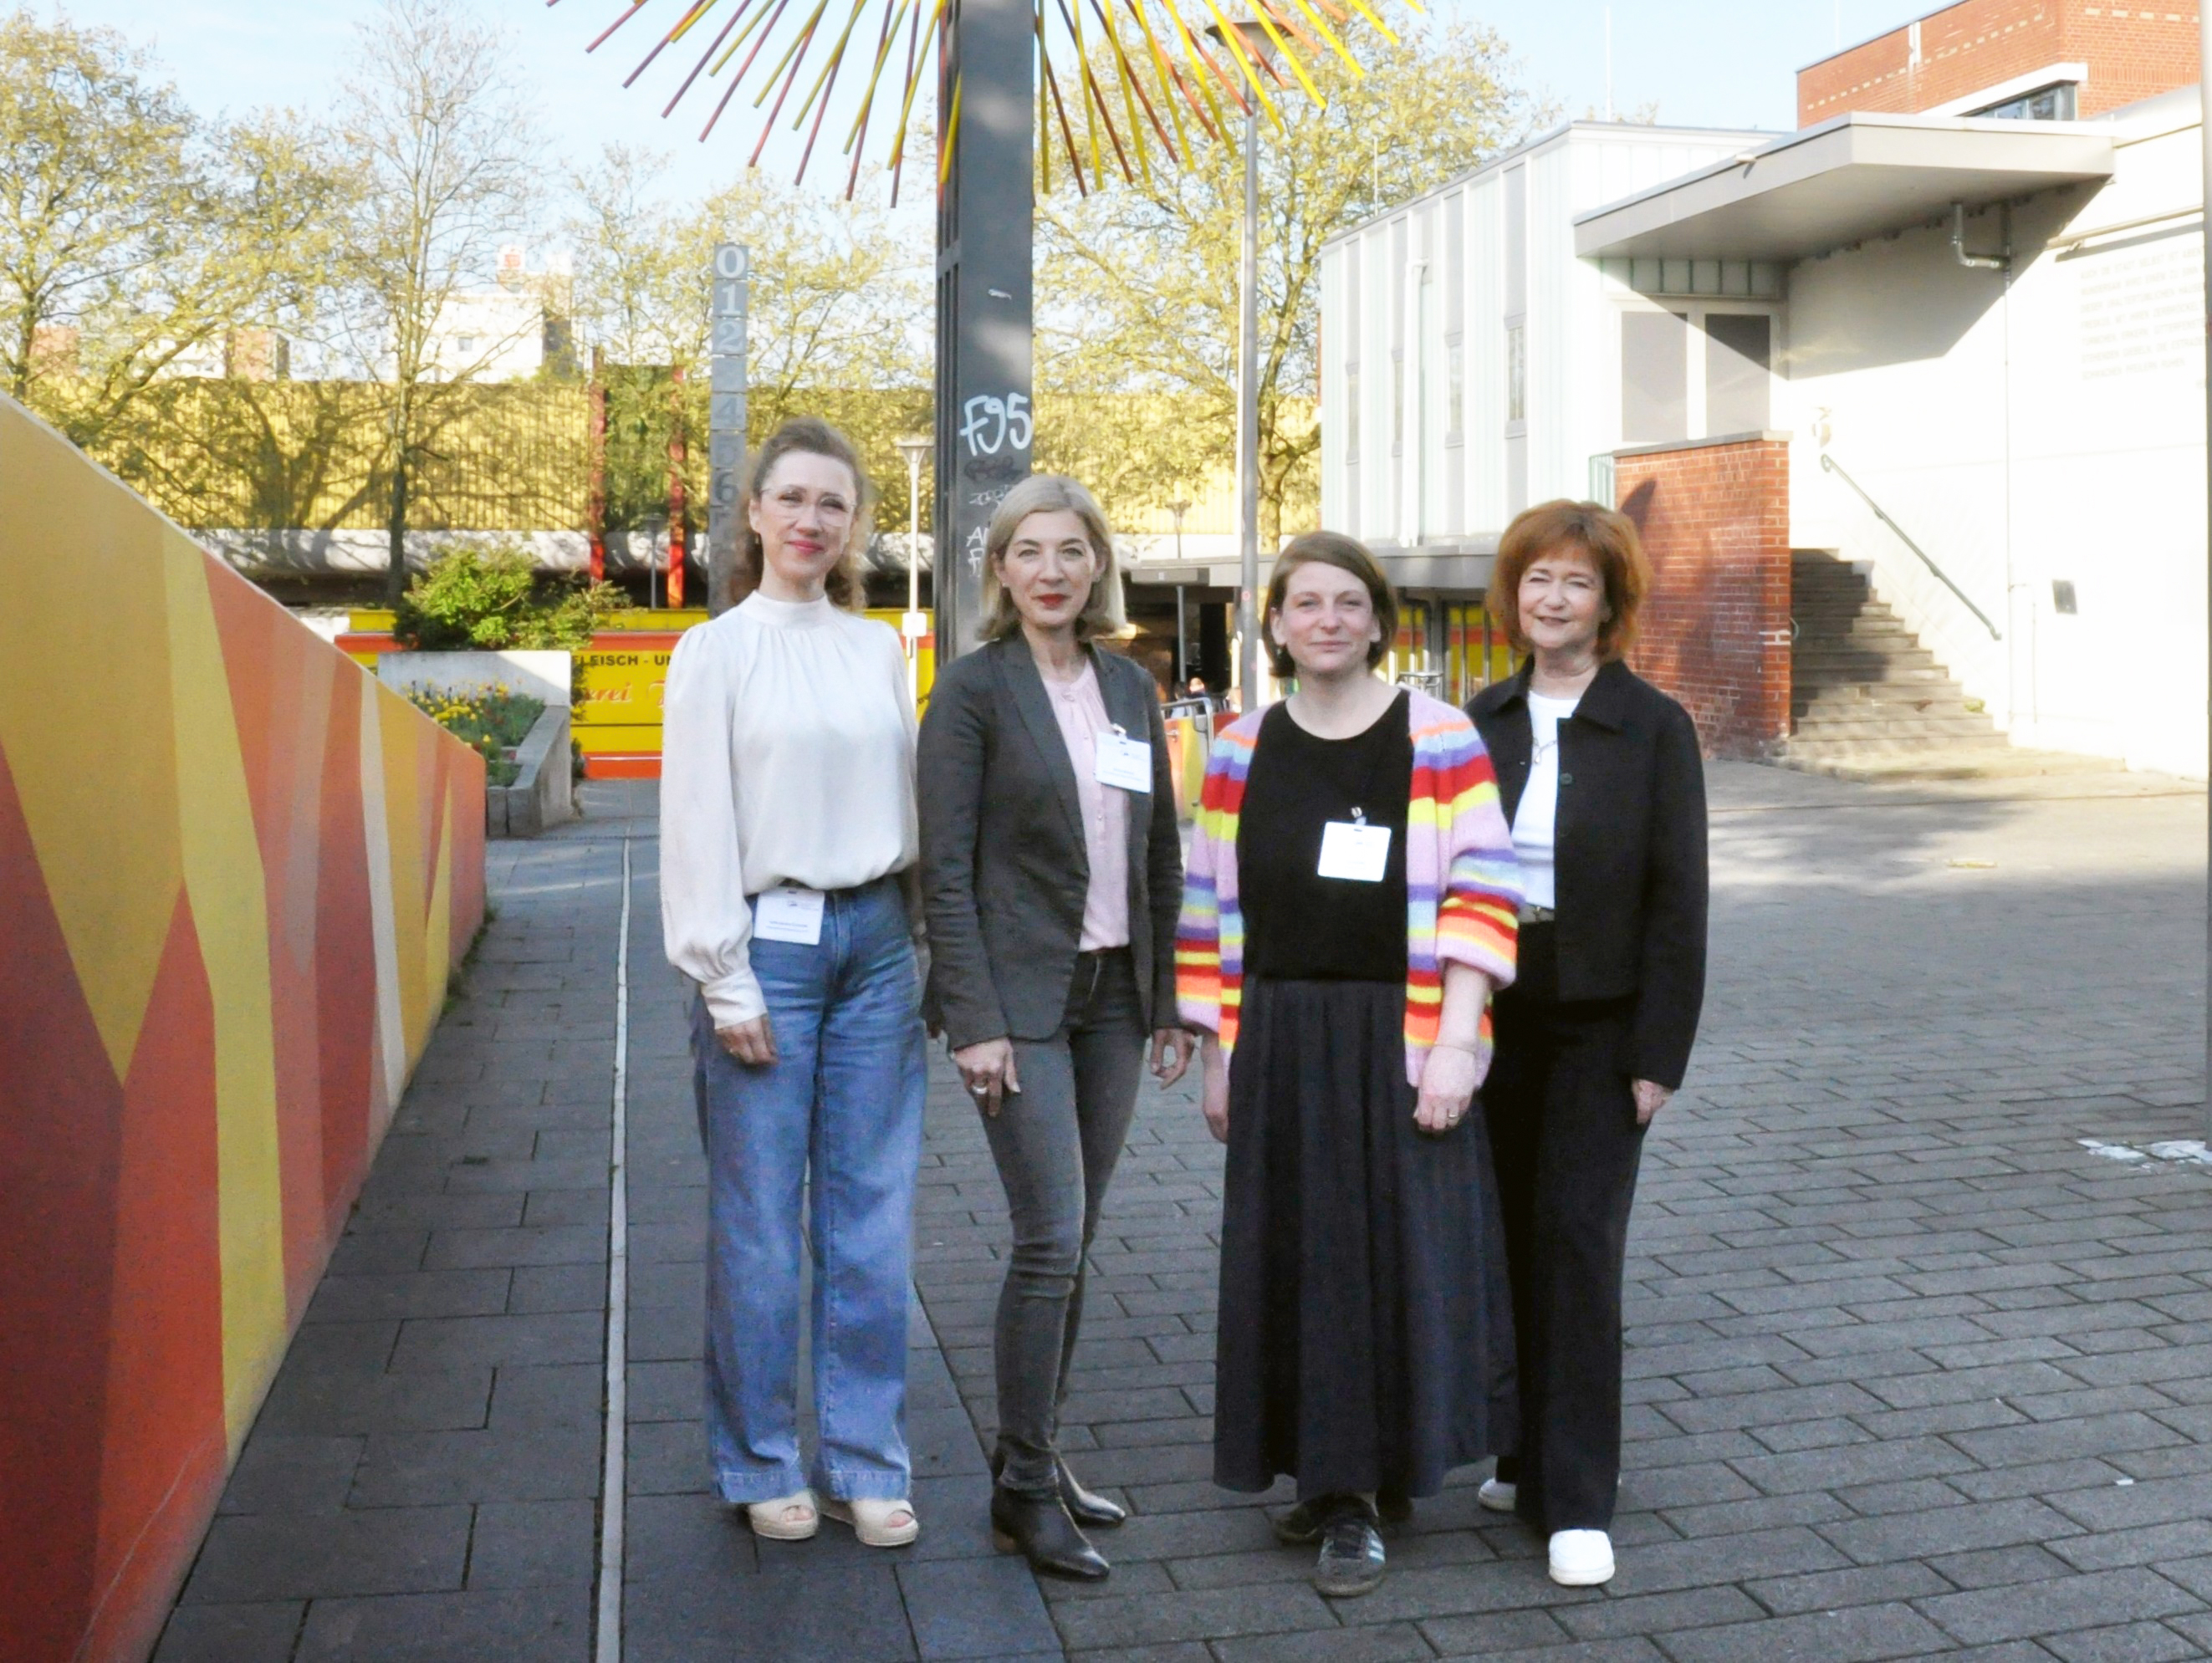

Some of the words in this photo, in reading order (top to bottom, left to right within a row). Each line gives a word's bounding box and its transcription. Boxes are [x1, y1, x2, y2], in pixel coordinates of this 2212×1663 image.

[716, 245, 746, 278] 0
[721, 283, 742, 315] 1
[717, 321, 744, 353] 2
